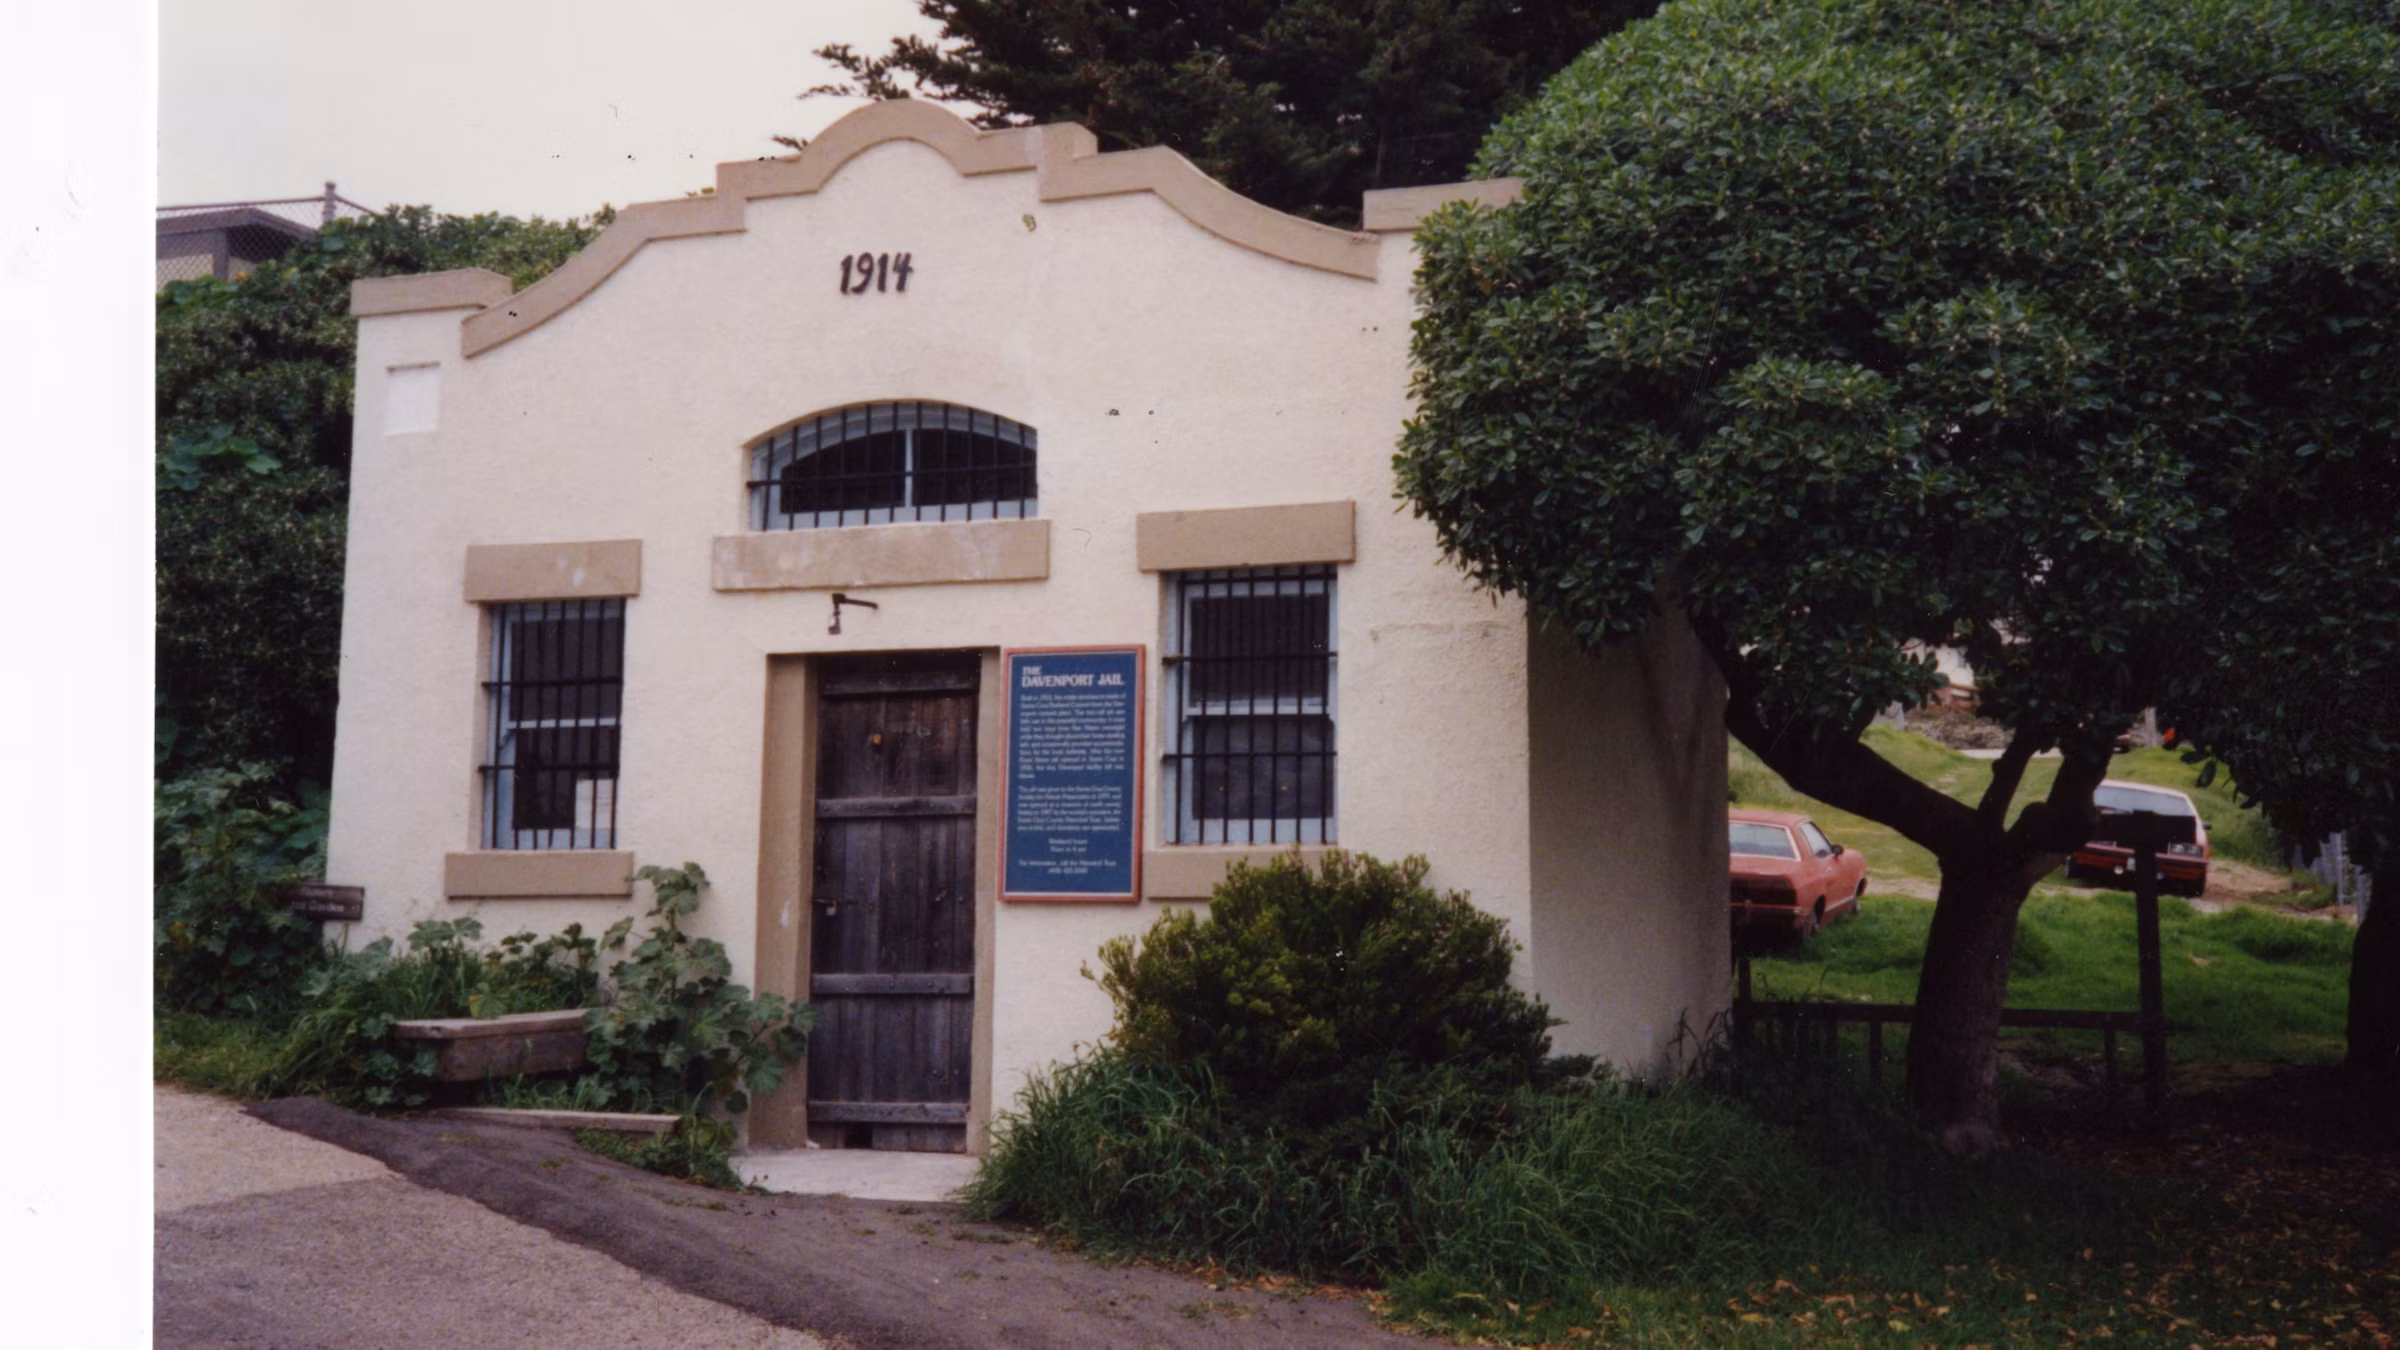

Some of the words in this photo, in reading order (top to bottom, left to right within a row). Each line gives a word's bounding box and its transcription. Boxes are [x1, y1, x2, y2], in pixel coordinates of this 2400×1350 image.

[840, 251, 914, 294] 1914
[1022, 666, 1041, 675] THE
[1022, 674, 1094, 688] DAVENPORT
[1098, 673, 1125, 686] JAIL
